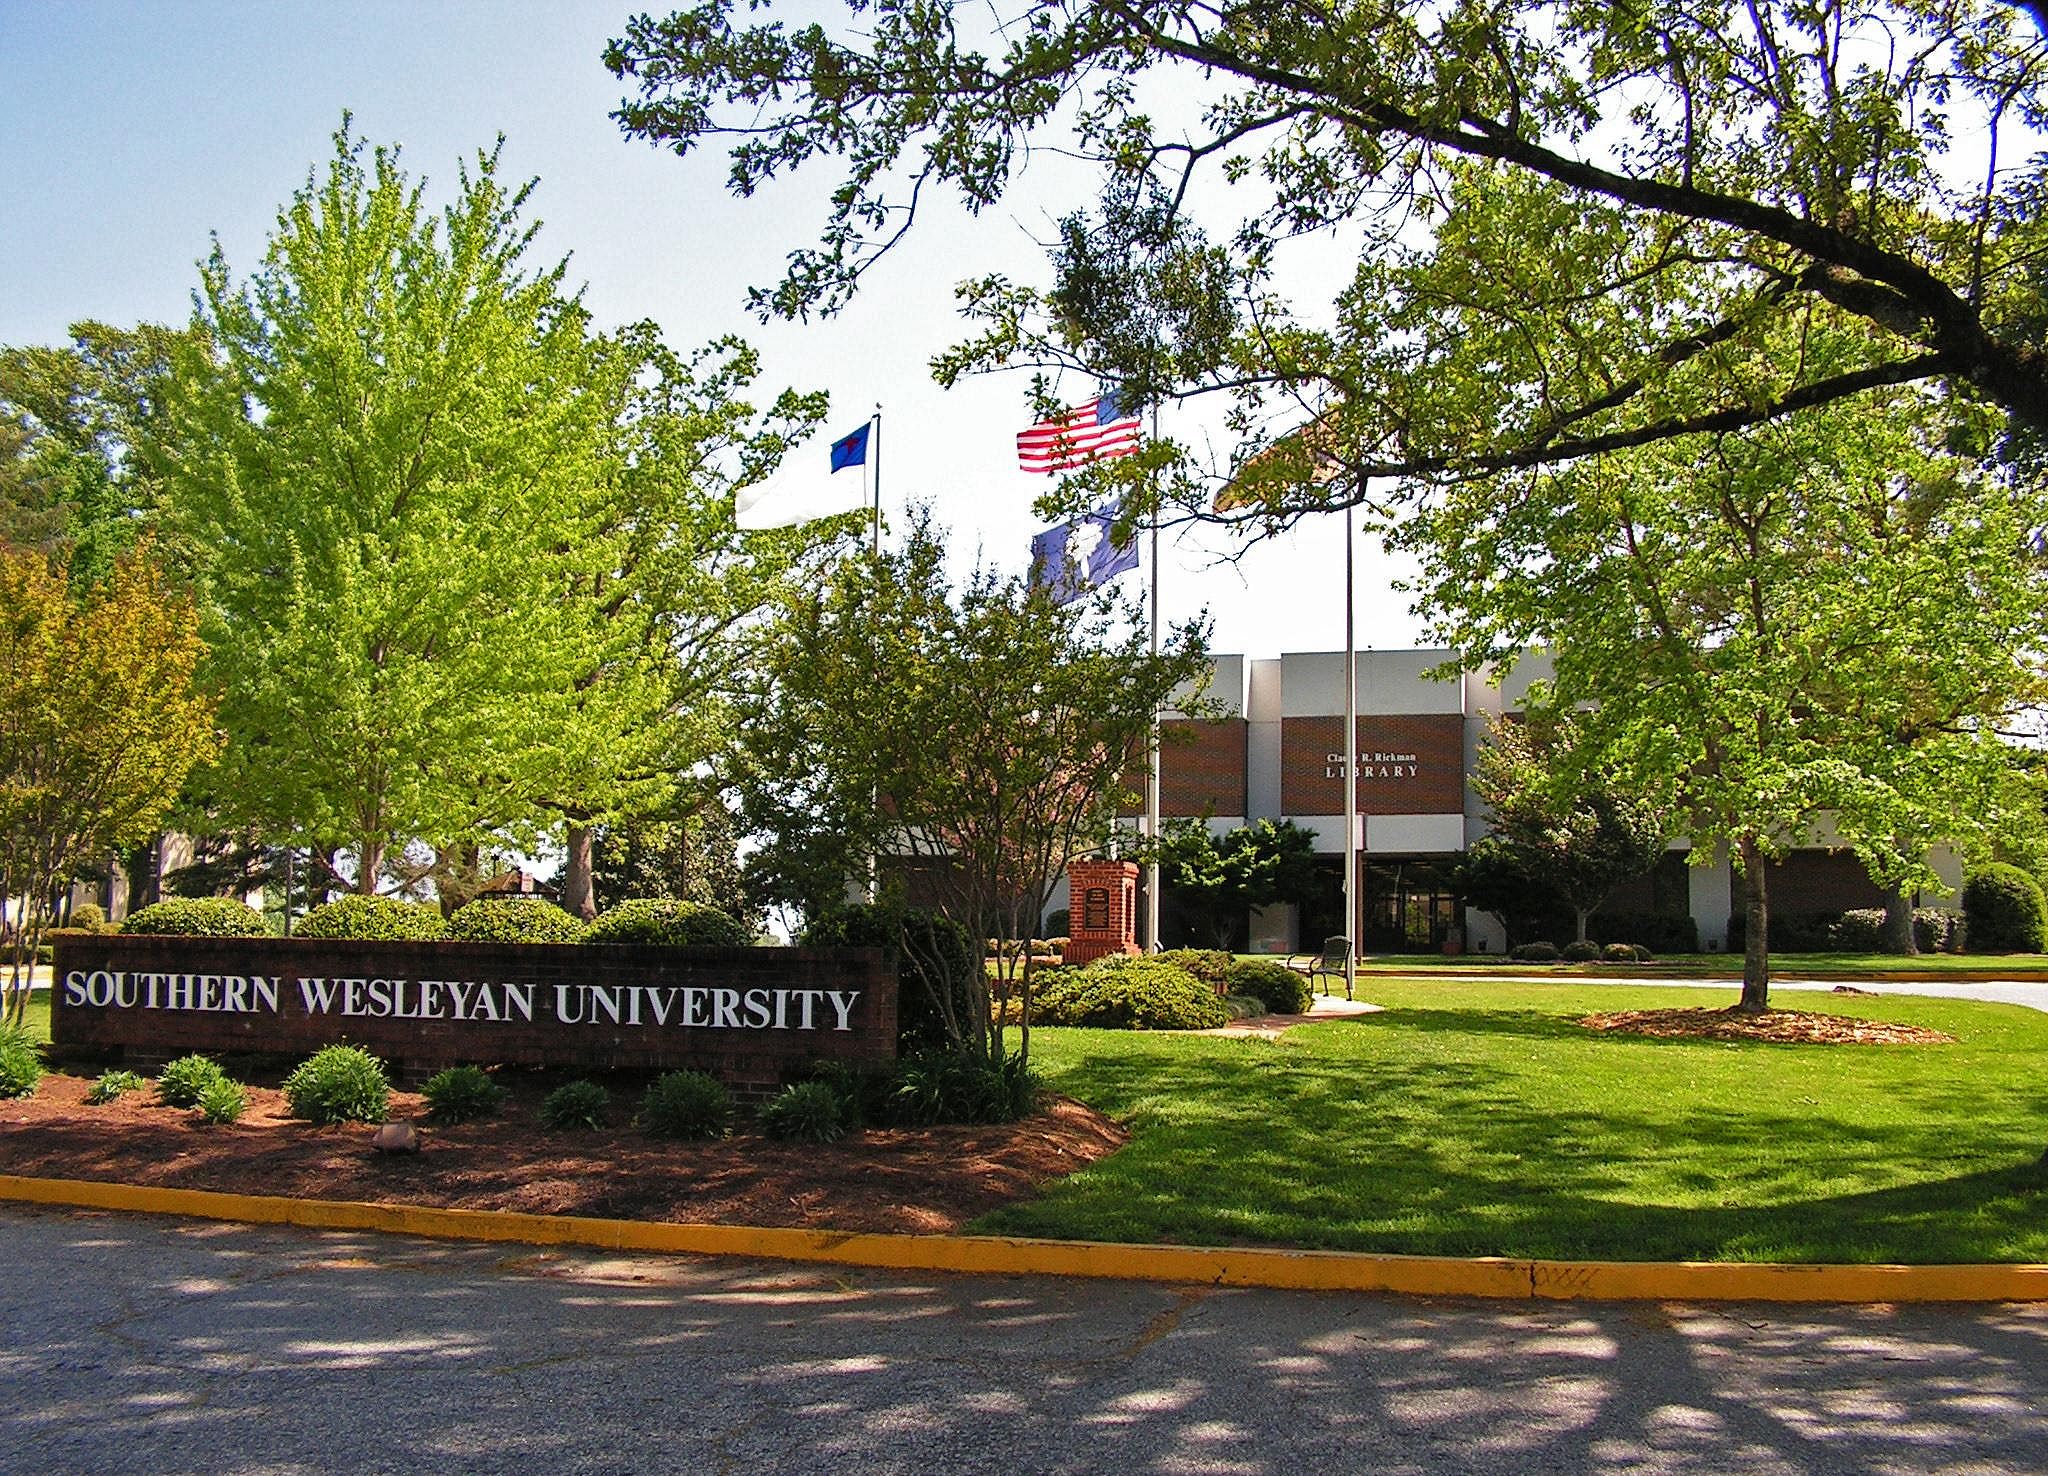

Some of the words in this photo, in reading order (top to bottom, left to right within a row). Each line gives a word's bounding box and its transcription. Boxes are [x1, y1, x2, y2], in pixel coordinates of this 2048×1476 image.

[1362, 753, 1372, 761] R.
[1375, 753, 1416, 762] Rickman
[1326, 765, 1417, 778] LIBRARY
[64, 970, 281, 1014] SOUTHERN
[297, 977, 535, 1022] WESLEYAN
[552, 984, 861, 1031] UNIVERSITY
